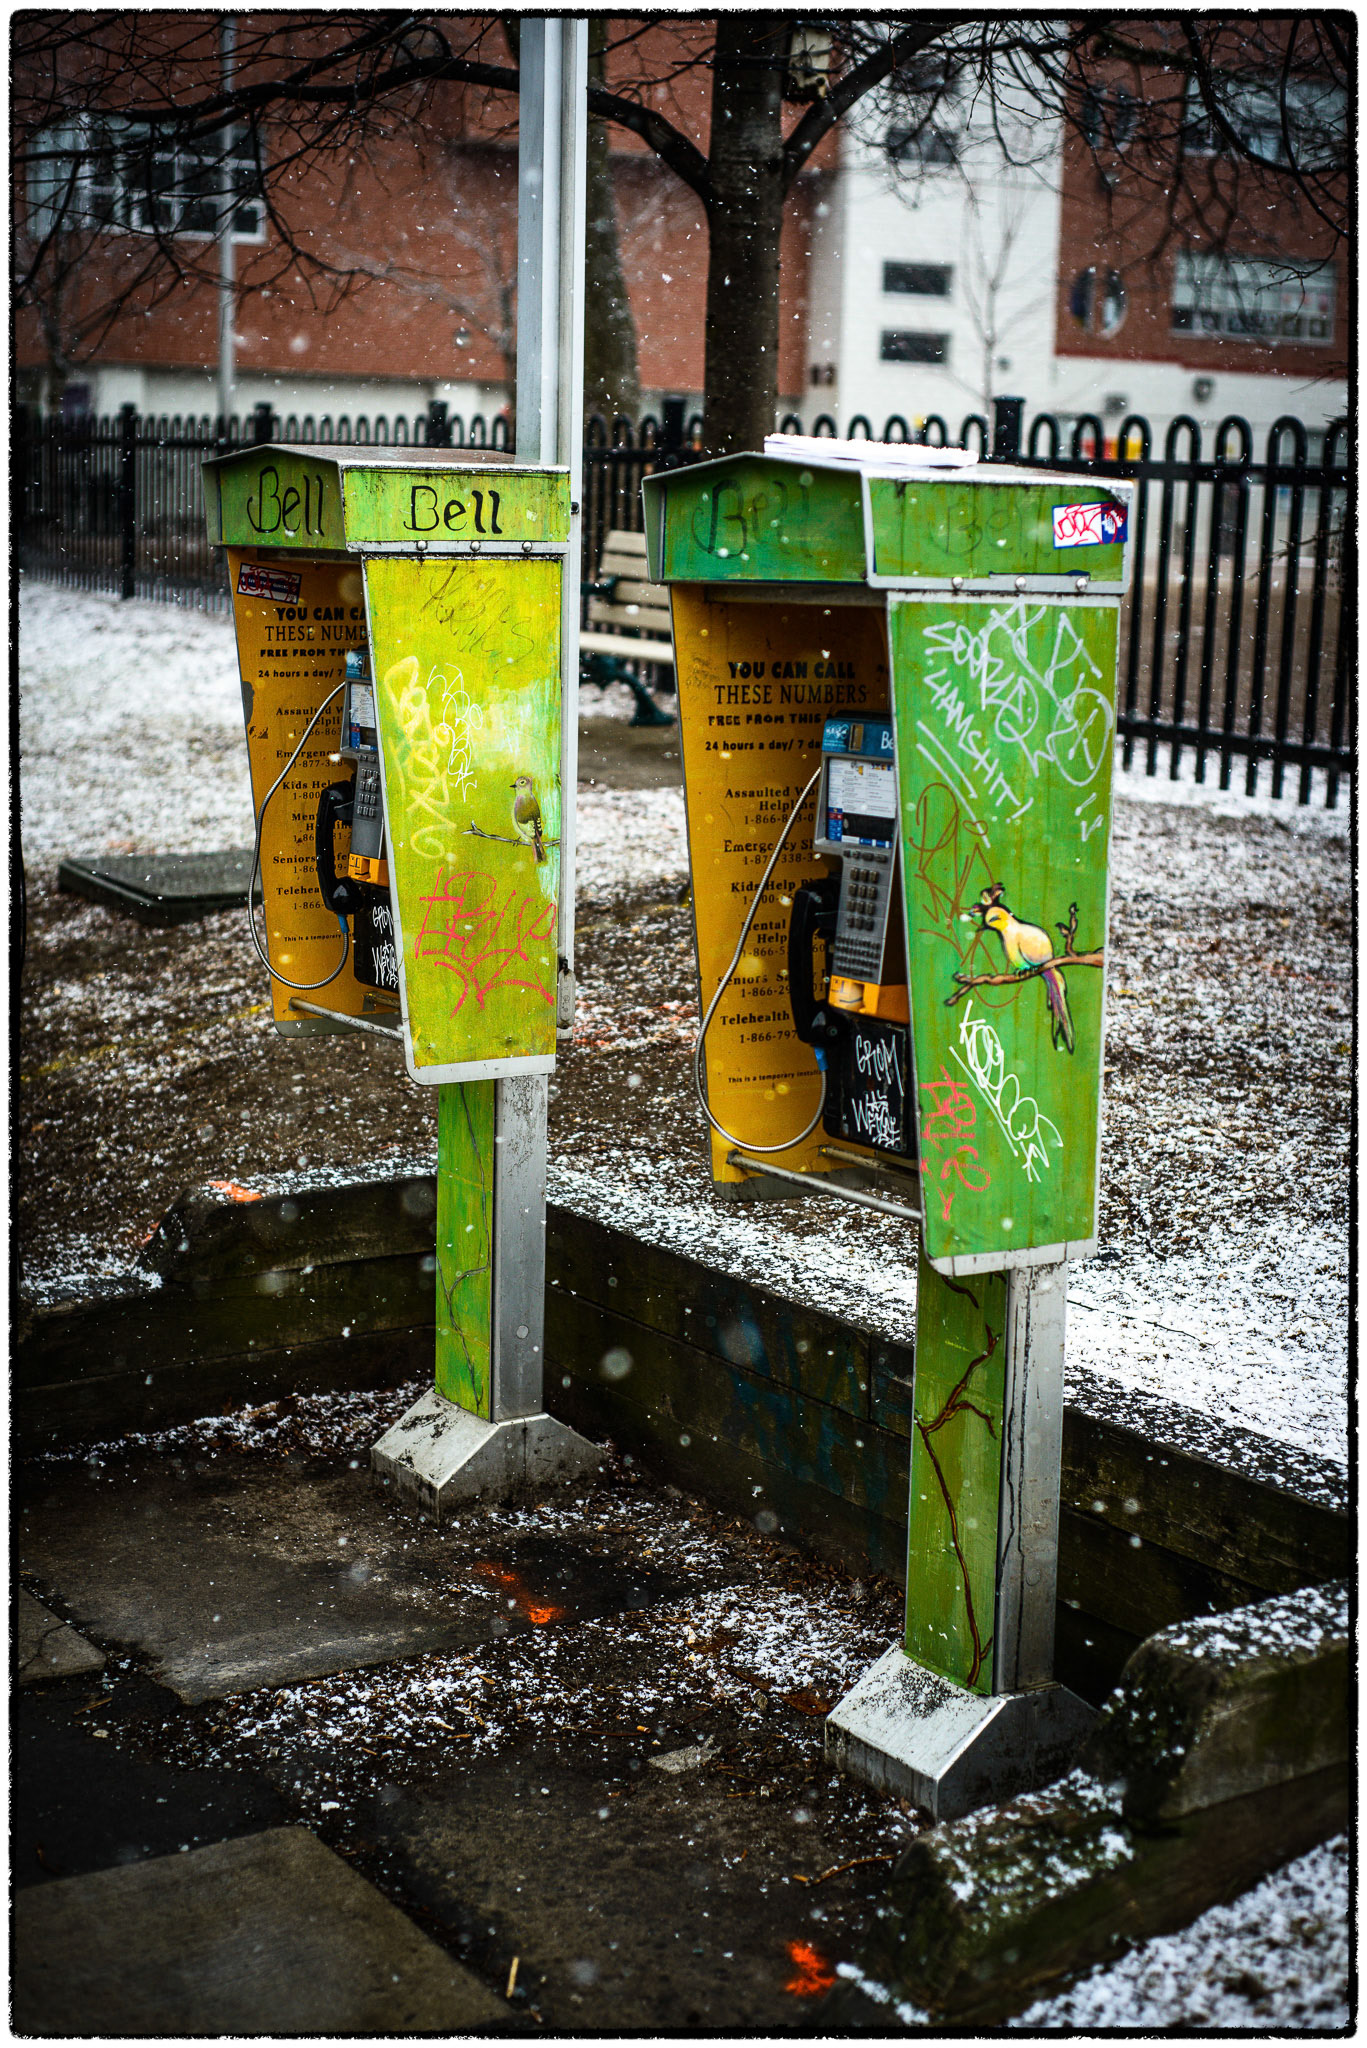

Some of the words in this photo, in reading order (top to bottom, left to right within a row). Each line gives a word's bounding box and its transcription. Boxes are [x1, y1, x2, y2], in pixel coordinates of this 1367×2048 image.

[246, 466, 325, 537] Bell
[403, 485, 503, 534] Bell
[276, 607, 307, 621] YOU
[313, 607, 344, 621] CAN
[350, 607, 366, 621] CA
[265, 625, 314, 641] THESE
[321, 625, 368, 641] NUMB
[260, 649, 288, 658] FREE
[293, 648, 325, 657] FROM
[258, 669, 270, 678] 24
[273, 669, 300, 677] hours
[312, 668, 334, 678] day/
[727, 661, 765, 679] YOU
[771, 661, 808, 679] CAN
[814, 661, 856, 679] CALL
[714, 684, 773, 705] THESE
[780, 684, 867, 705] NUMBERS
[276, 706, 332, 716] Assaultd
[708, 715, 741, 727] FREE
[746, 714, 785, 725] FROM
[789, 713, 823, 724] THIS
[705, 741, 718, 751] 24
[722, 740, 754, 751] hours
[758, 741, 765, 750] a
[768, 738, 794, 751] day/
[797, 739, 804, 750] 7
[807, 739, 822, 749] da
[880, 731, 895, 750] Be
[282, 780, 308, 790] Kids
[725, 786, 790, 799] Assaulted
[759, 800, 816, 812] Helplne
[273, 854, 316, 864] Seniors
[276, 885, 320, 895] Telehea
[757, 932, 788, 944] Help
[720, 1010, 790, 1026] Telehealth
[759, 1071, 795, 1081] temporary
